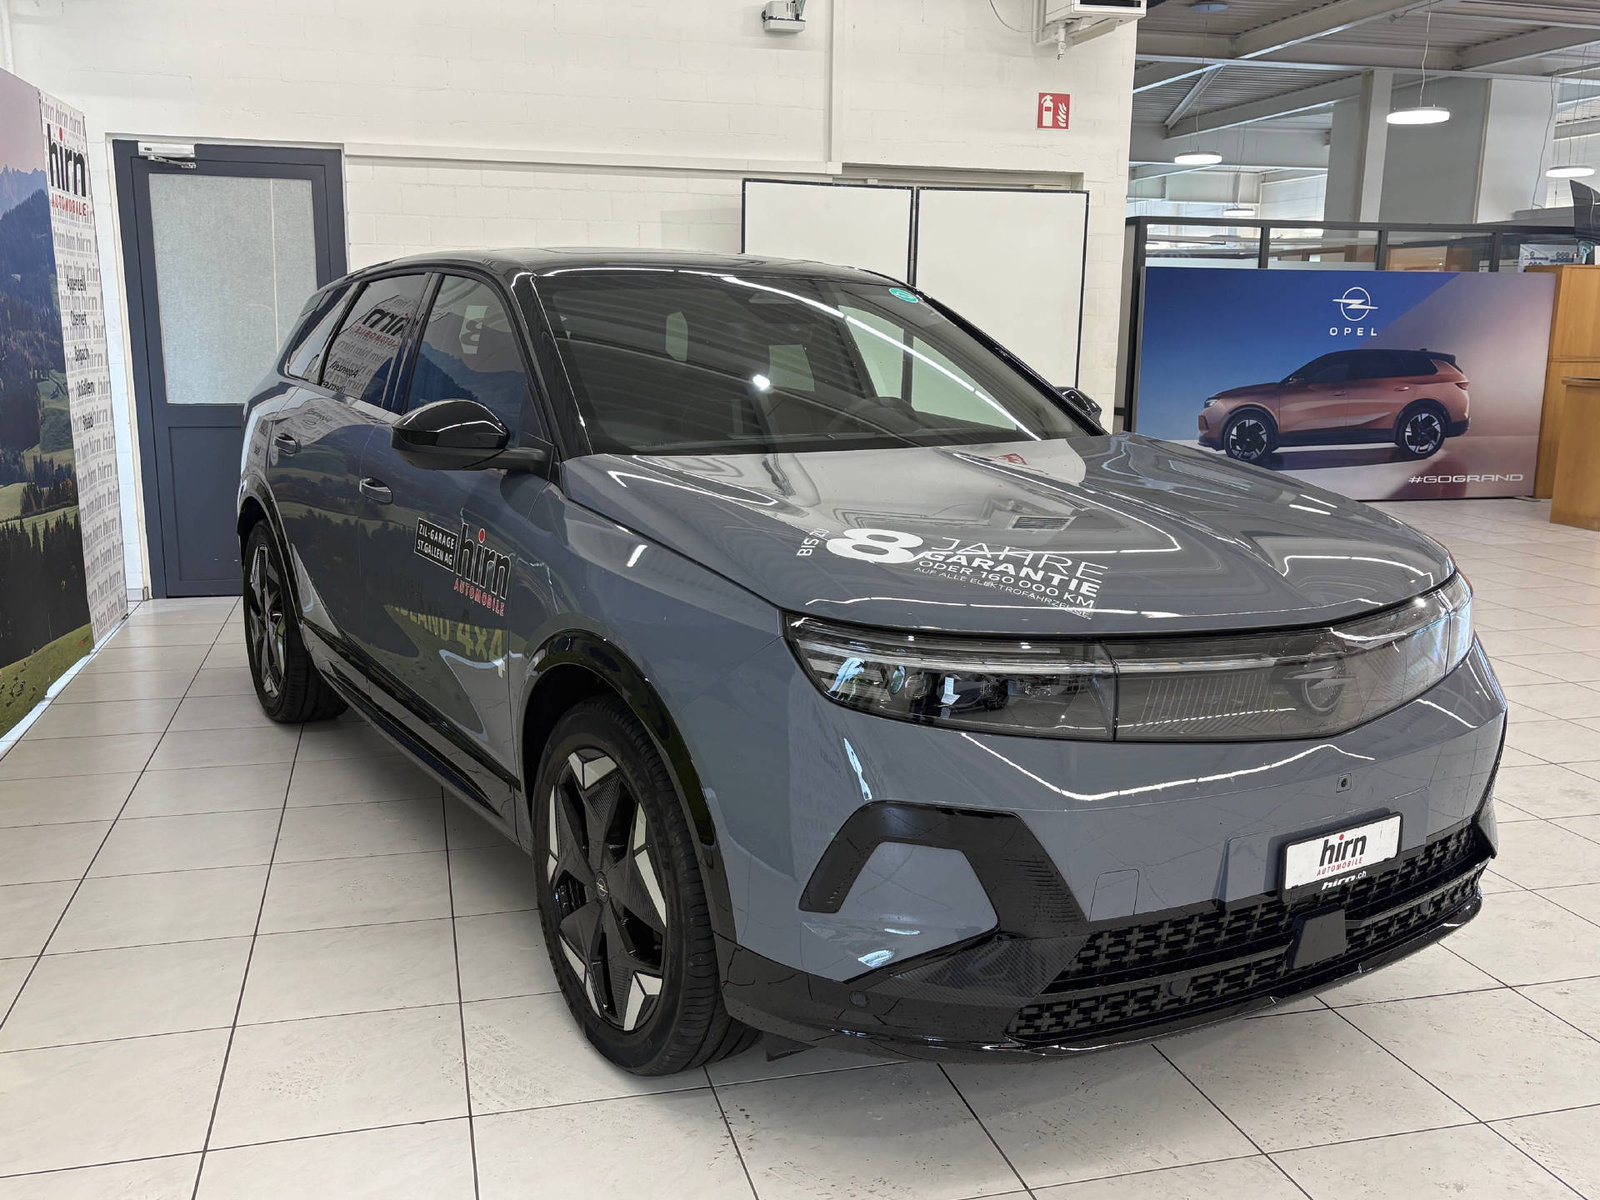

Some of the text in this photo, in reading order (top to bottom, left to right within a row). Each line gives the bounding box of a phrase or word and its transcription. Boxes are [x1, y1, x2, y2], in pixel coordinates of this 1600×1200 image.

[47, 123, 86, 197] hirn
[51, 193, 87, 216] AUTOMOBILE
[76, 231, 92, 253] hirn
[1329, 327, 1378, 336] OPEL
[97, 461, 113, 479] hirn
[1408, 474, 1523, 484] #GOGRAND
[418, 523, 455, 549] ZIL-GARAGE
[796, 537, 820, 556] BIS
[826, 528, 924, 564] 8
[417, 539, 453, 566] ST.GALLEN AG
[456, 522, 512, 600] hirn
[931, 536, 1109, 583] JAHRE
[914, 567, 937, 575] AUF
[939, 572, 968, 582] ALLE
[918, 560, 1095, 609] ODER 160 000 KM
[924, 551, 1101, 598] GARANTIE
[453, 578, 505, 617] AUTOMOBILE
[1319, 834, 1368, 866] hirn
[1316, 856, 1363, 876] AUTOMOBILE
[1321, 870, 1367, 890] hirn.ch
